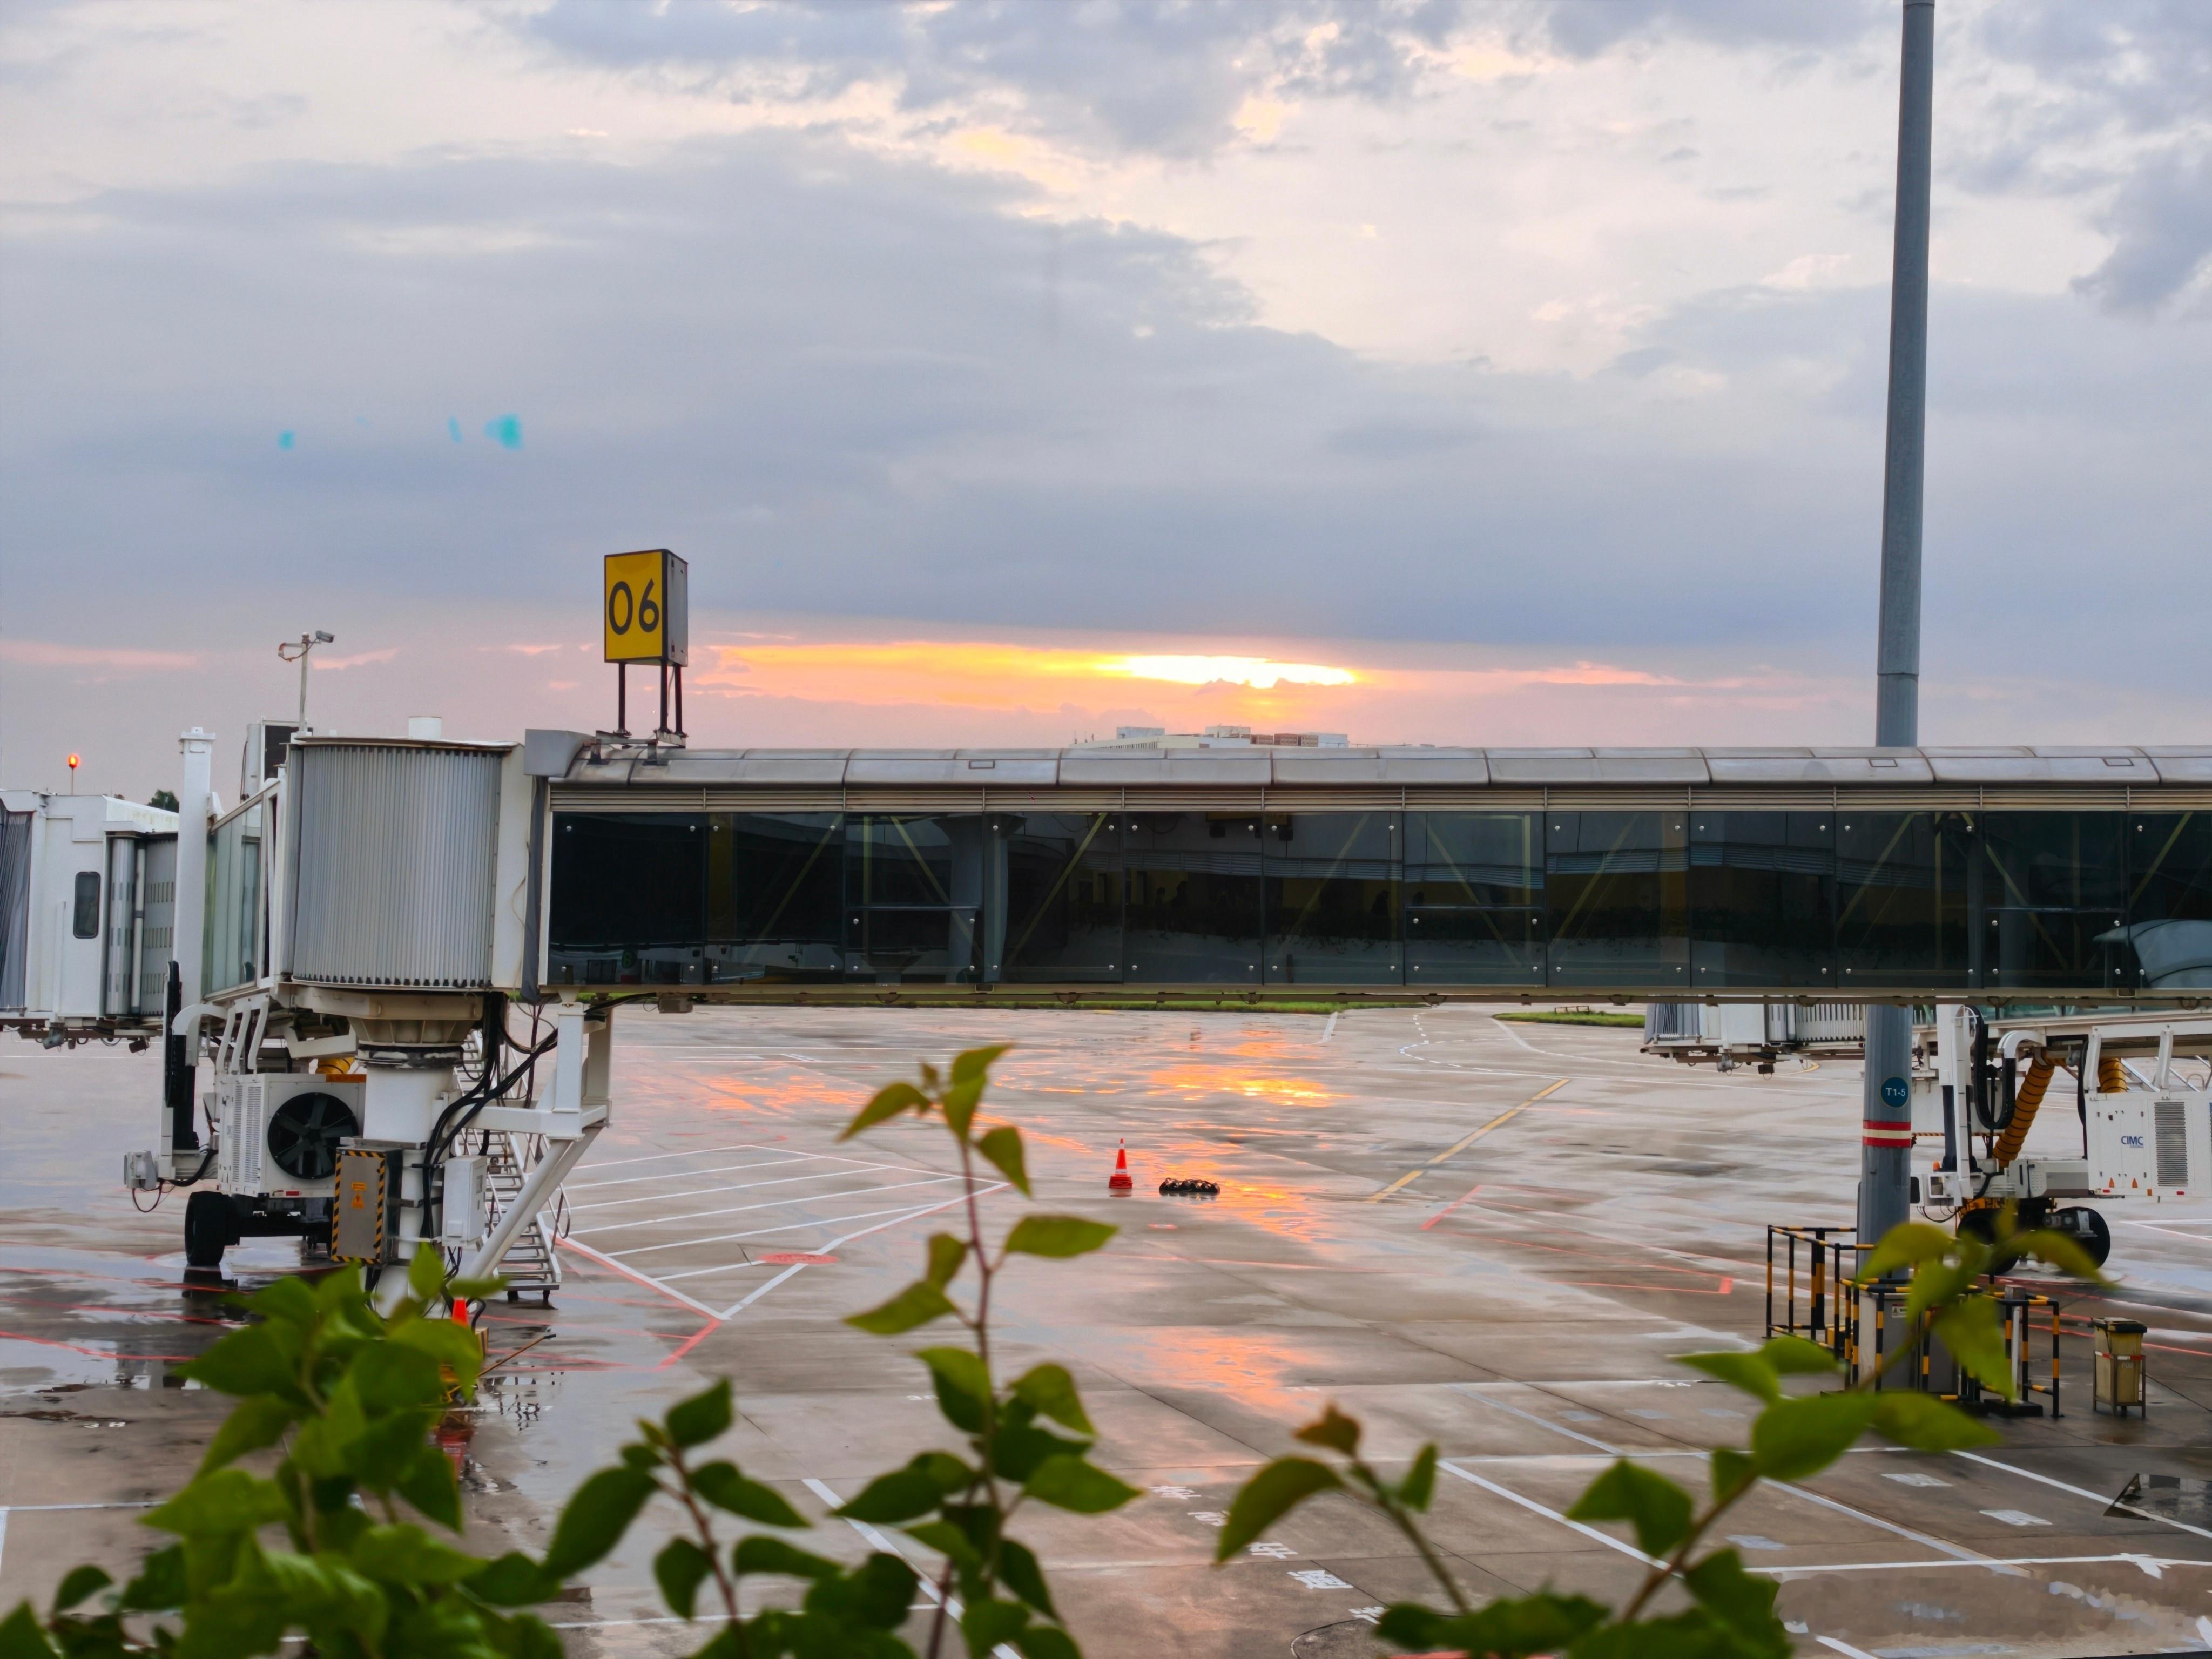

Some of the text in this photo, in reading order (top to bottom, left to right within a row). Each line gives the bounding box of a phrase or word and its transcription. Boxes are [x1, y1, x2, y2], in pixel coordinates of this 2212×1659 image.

[609, 578, 659, 635] 06
[1885, 1088, 1906, 1097] T1-5
[2121, 1136, 2143, 1145] CIMC
